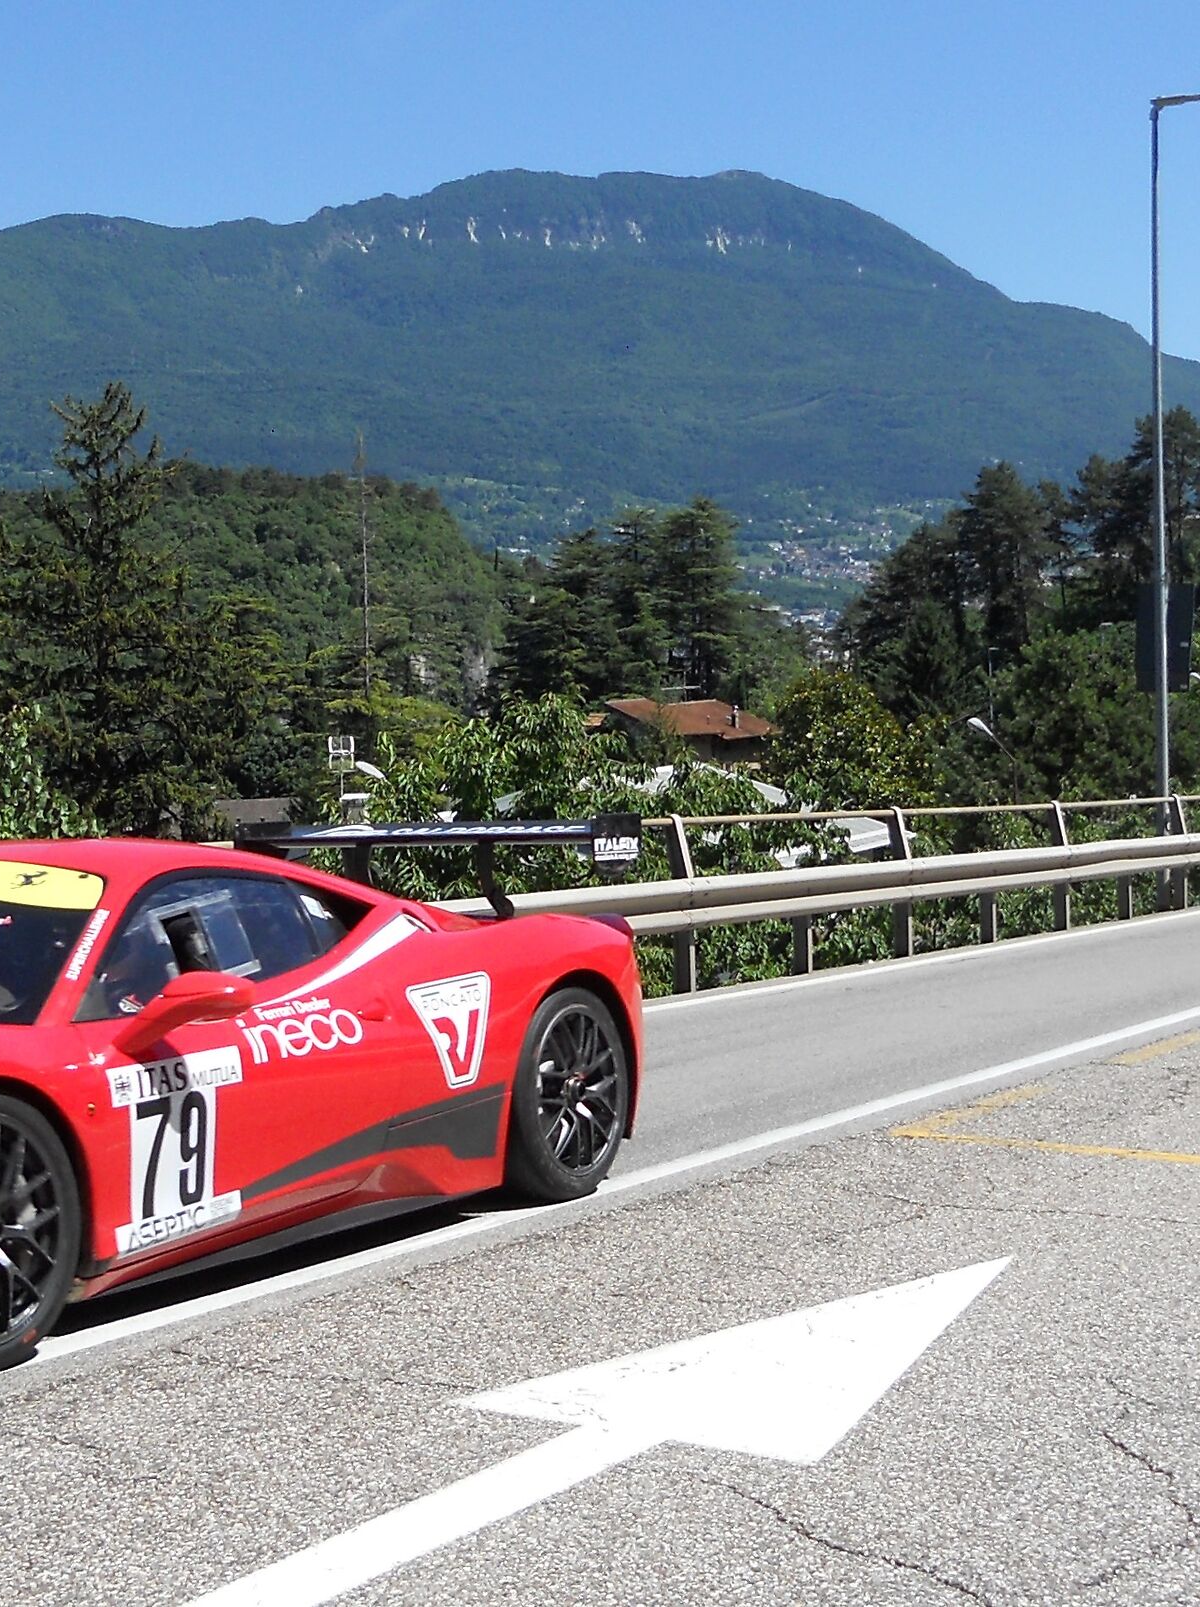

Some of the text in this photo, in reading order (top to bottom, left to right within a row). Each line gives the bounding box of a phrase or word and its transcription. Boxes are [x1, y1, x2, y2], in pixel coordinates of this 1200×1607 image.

[235, 1009, 363, 1065] ineco
[136, 1062, 240, 1098] ITAS MUTUA
[136, 1091, 207, 1220] 79
[126, 1206, 205, 1253] ASEPTIC
